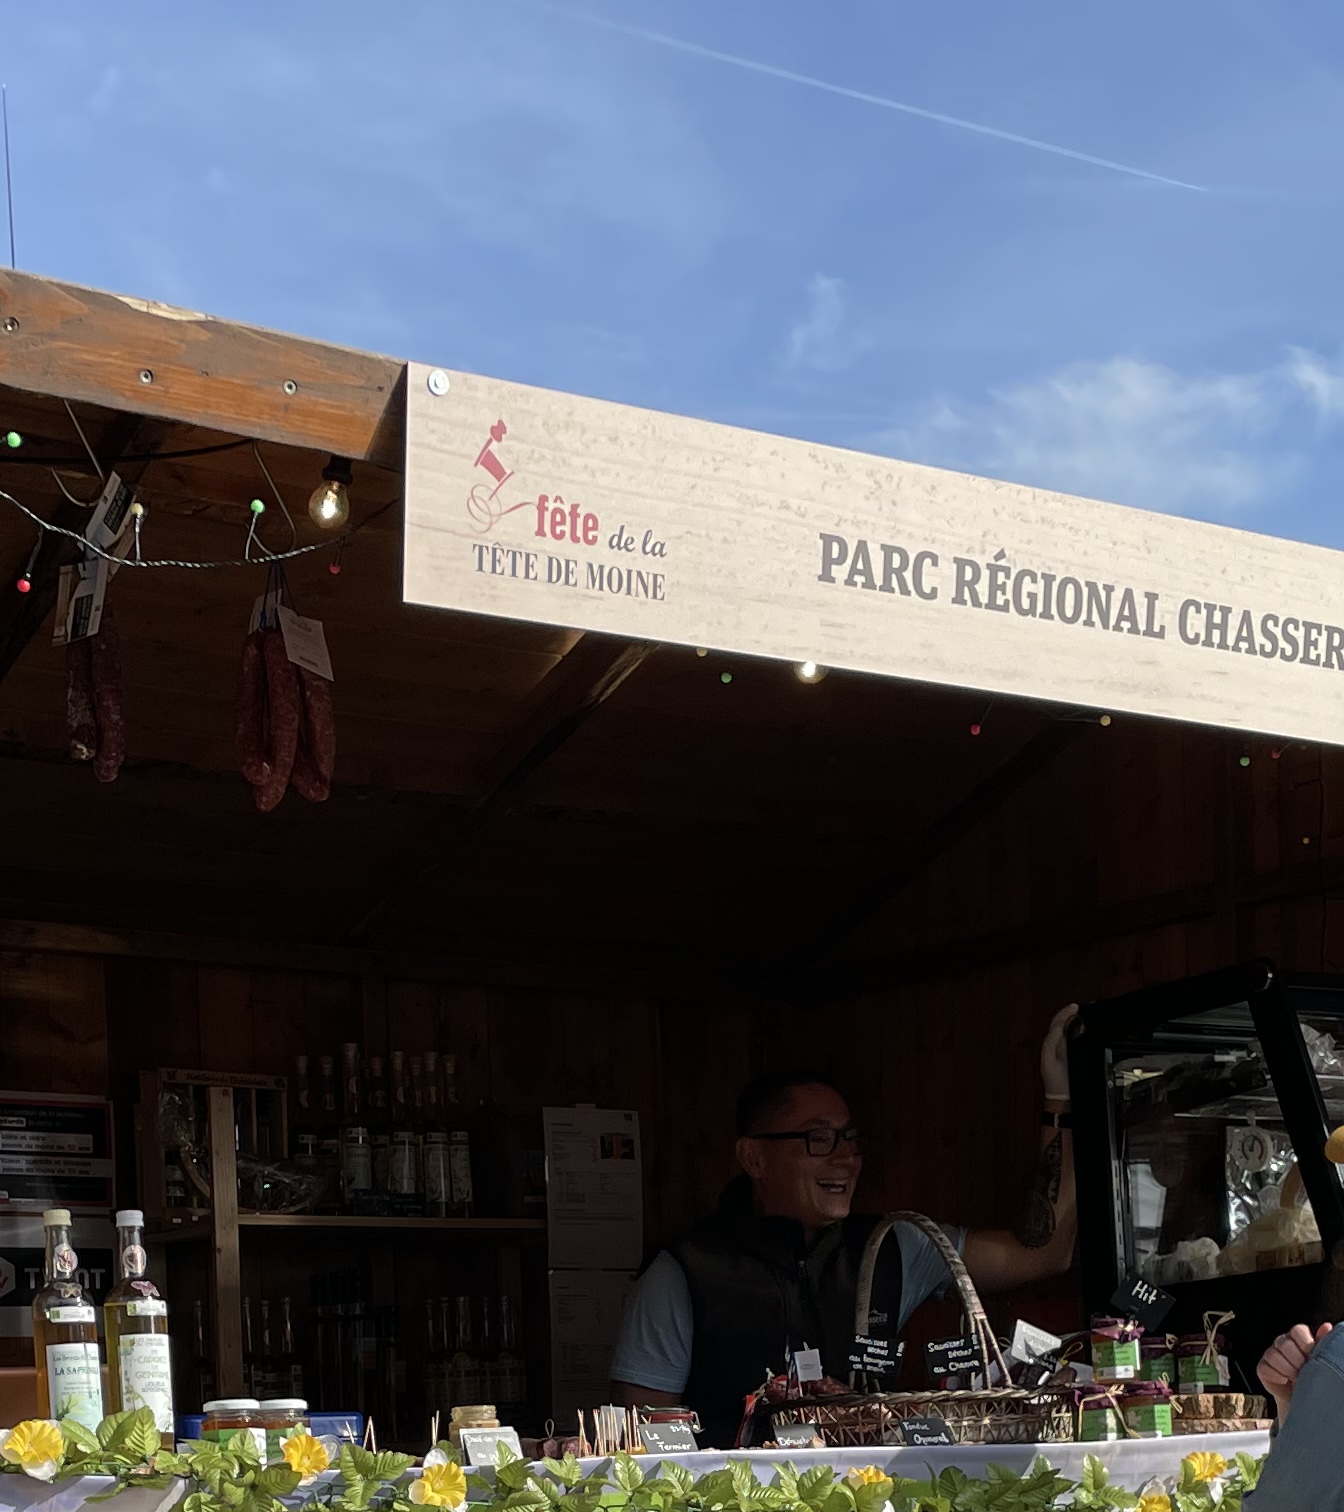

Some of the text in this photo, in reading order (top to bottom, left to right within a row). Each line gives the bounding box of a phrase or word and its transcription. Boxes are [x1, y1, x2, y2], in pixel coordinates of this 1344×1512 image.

[535, 493, 667, 559] fête de la
[473, 542, 666, 602] TÊTE DE MOINE
[817, 532, 939, 602] PARC
[951, 547, 1166, 640] RÉGIONAL
[24, 1267, 106, 1290] TNT
[1131, 1280, 1158, 1304] Hit
[645, 1429, 660, 1441] Le
[656, 1441, 692, 1452] Fermier
